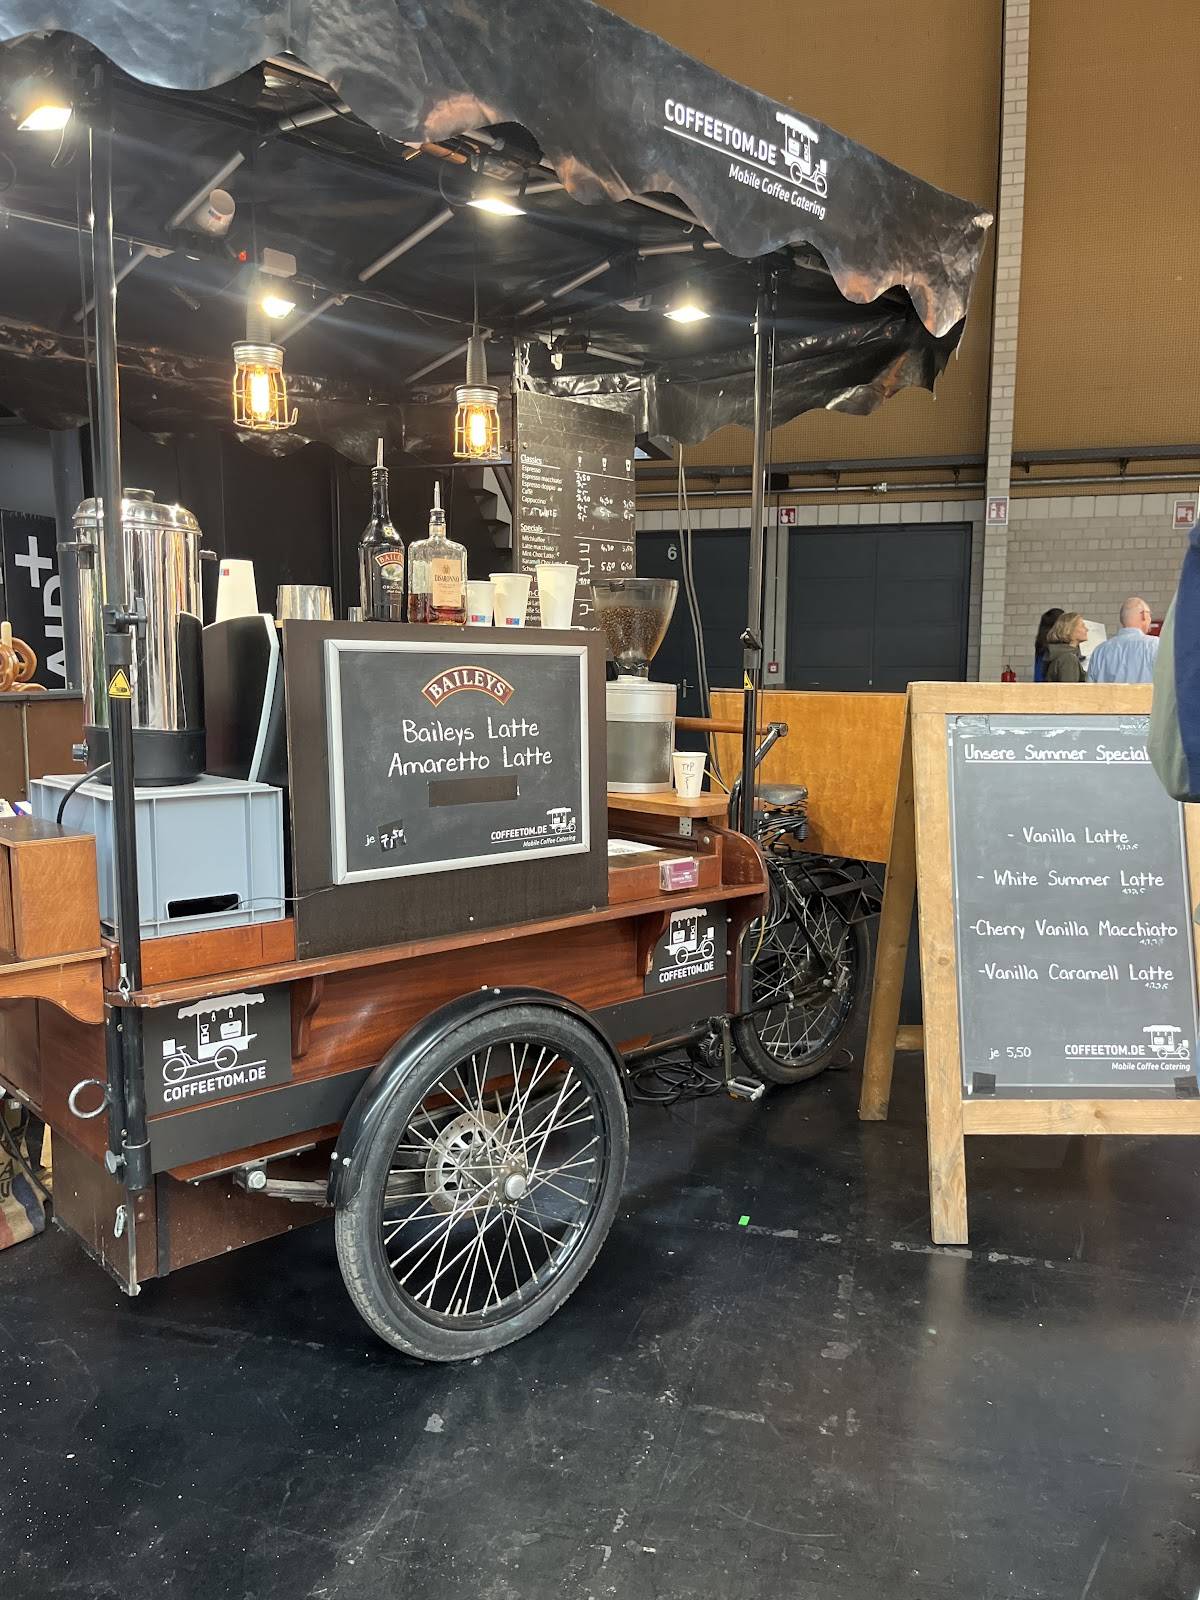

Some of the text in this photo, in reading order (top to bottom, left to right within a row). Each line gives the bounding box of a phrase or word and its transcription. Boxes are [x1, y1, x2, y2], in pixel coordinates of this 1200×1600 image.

[664, 99, 777, 166] COFFEETOM.DE
[729, 163, 826, 221] Mobile Coffee Catering
[520, 454, 542, 464] Classics
[522, 465, 541, 473] Espresso
[522, 472, 540, 480] Espresso
[522, 480, 540, 488] Espresso
[522, 496, 546, 504] Cappuccino
[520, 523, 543, 533] Specials
[667, 546, 677, 560] 6
[428, 670, 506, 699] BAILEYS
[402, 717, 540, 746] Baileys Latte
[965, 743, 1150, 764] Unsere Summer Special
[388, 746, 553, 778] Amaretto Latte
[491, 825, 547, 840] COFFEETOM.DE
[1023, 827, 1076, 843] Vanilla
[1085, 827, 1129, 843] Latte
[365, 834, 376, 847] je
[522, 835, 576, 848] Mobile Coffee Catering
[993, 869, 1039, 886] White
[1048, 870, 1110, 886] Summer
[1120, 870, 1165, 886] Latte
[1035, 919, 1088, 937] Vanilla
[1098, 920, 1178, 937] Macchiato
[659, 961, 715, 983] COFFEETOM.DE
[1048, 963, 1119, 981] Caramell
[1129, 963, 1175, 981] Latte
[989, 1047, 1032, 1060] je 5,50
[1064, 1044, 1146, 1056] COFFEETOM.DE
[1111, 1062, 1191, 1072] Mobile Coffee Catering
[163, 1066, 266, 1102] COFFEETOM.DE
